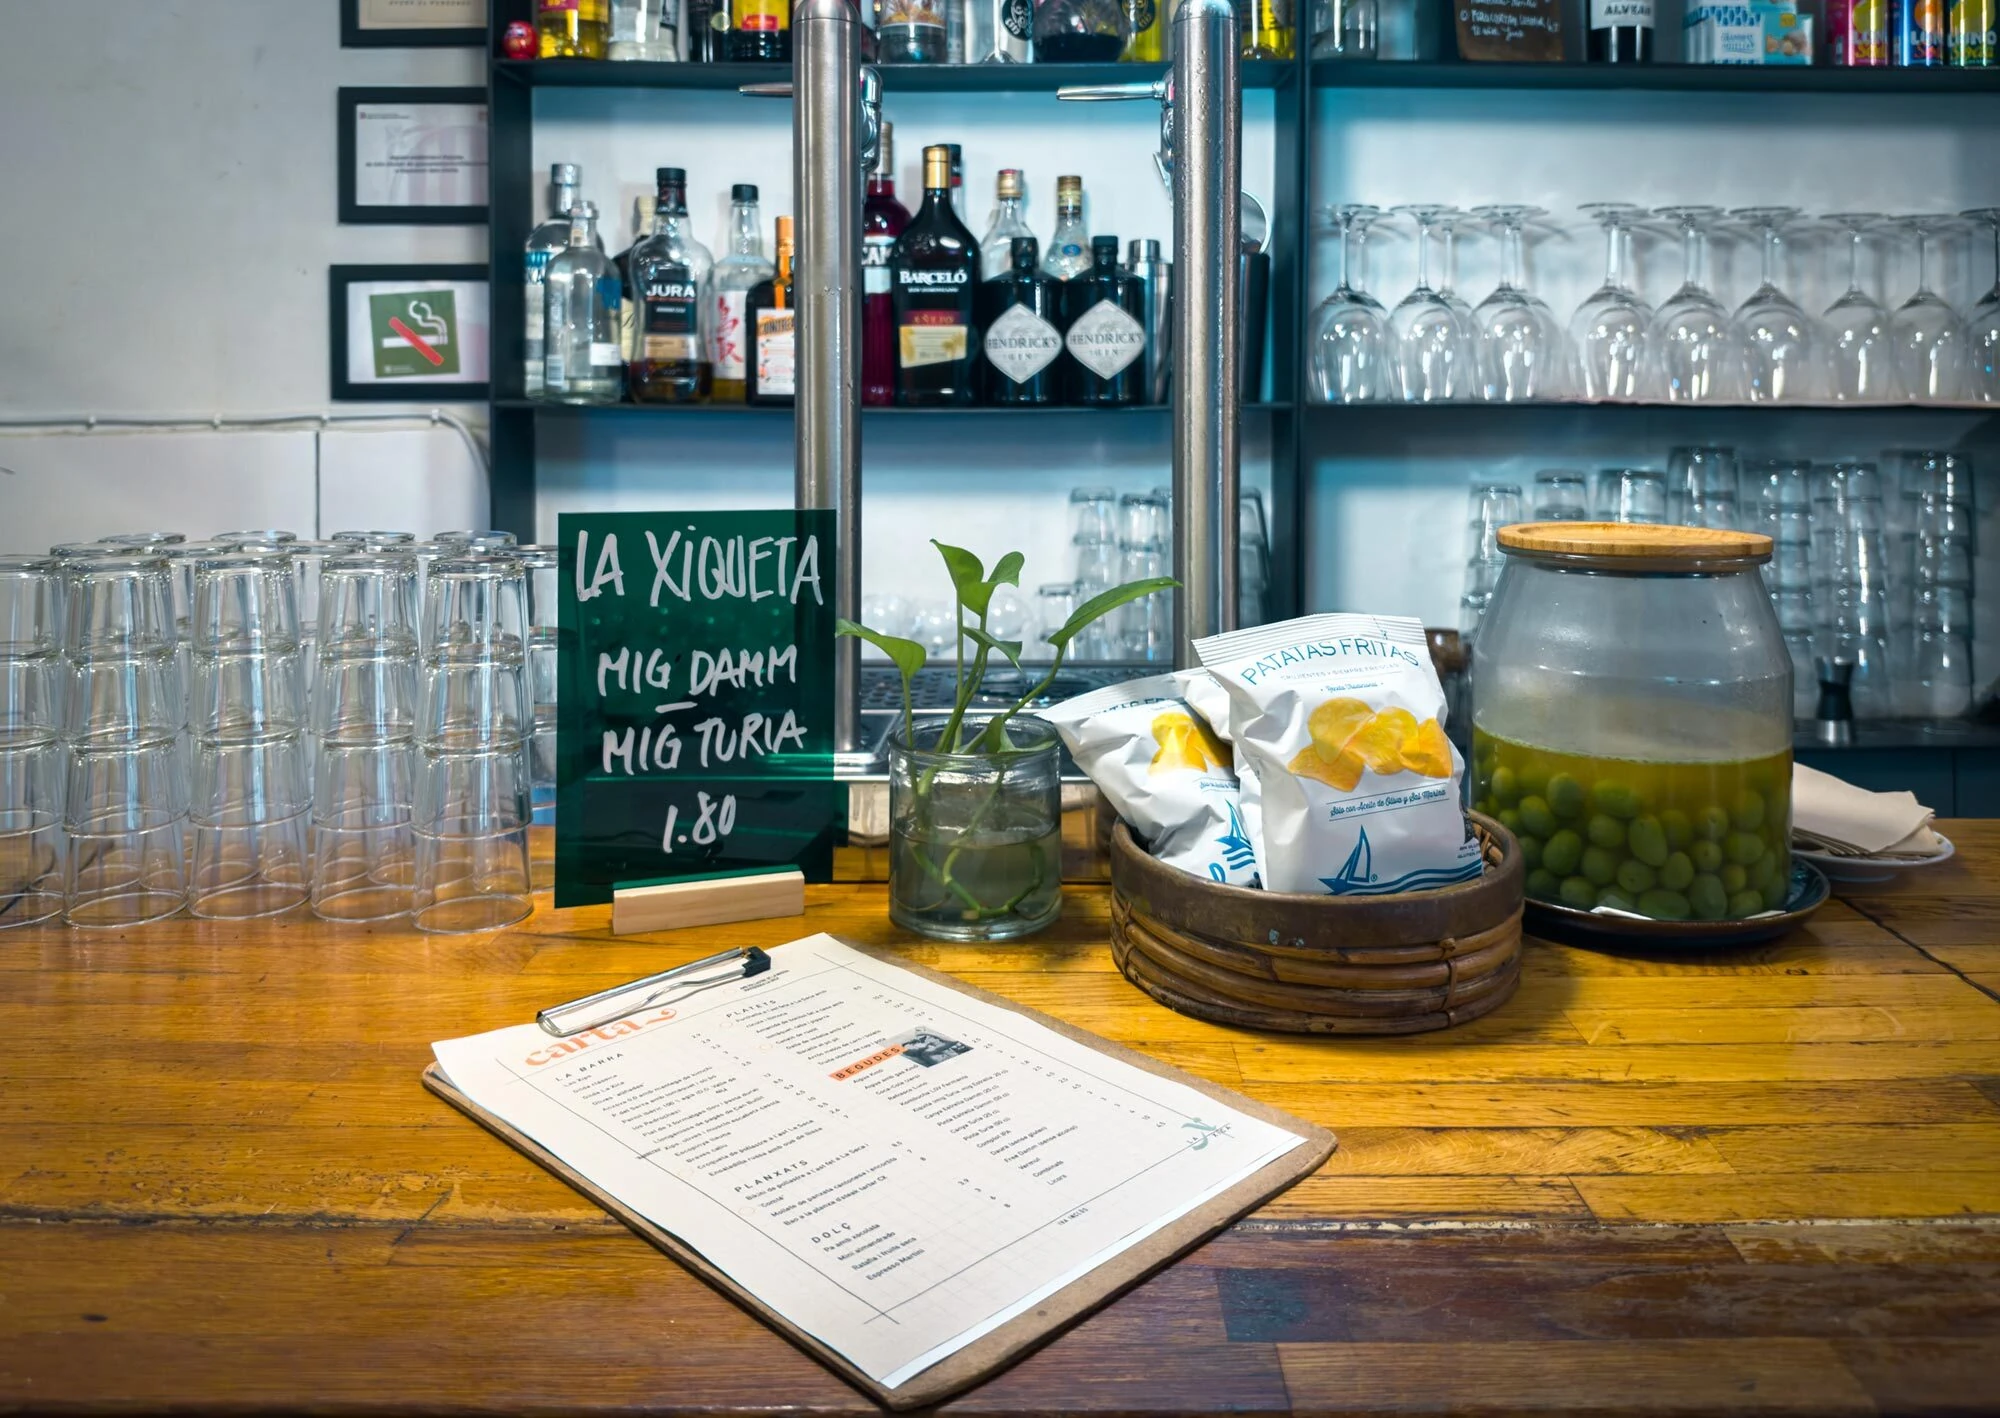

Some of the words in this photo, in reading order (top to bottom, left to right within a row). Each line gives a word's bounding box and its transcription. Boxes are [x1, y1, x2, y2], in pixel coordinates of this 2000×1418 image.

[646, 284, 696, 298] JURA
[899, 268, 967, 286] BARCELÓ
[576, 530, 625, 603] LA
[598, 646, 671, 697] MIG
[688, 643, 797, 697] DAMM
[1240, 641, 1336, 685] PATATAS
[1339, 638, 1419, 667] FRITAS
[602, 724, 681, 775] MIG
[693, 710, 808, 768] TURIA
[1357, 801, 1376, 811] Aceite
[1377, 799, 1384, 807] de
[1385, 796, 1402, 806] Oliva
[1422, 789, 1446, 800] Marina
[663, 790, 736, 854] 1.80
[525, 1019, 644, 1066] carta
[580, 1054, 623, 1072] BARRA
[836, 1047, 901, 1079] BEGUDES
[734, 1161, 807, 1192] PLANXATS
[812, 1223, 850, 1243] DOLÇ
[836, 1238, 852, 1247] amb
[852, 1224, 880, 1239] xocolata
[838, 1252, 854, 1260] Mini
[855, 1232, 895, 1253] almendrado
[880, 1246, 900, 1256] fruits
[900, 1238, 916, 1246] secs
[866, 1262, 900, 1280] Espresso
[898, 1250, 924, 1263] Martini
